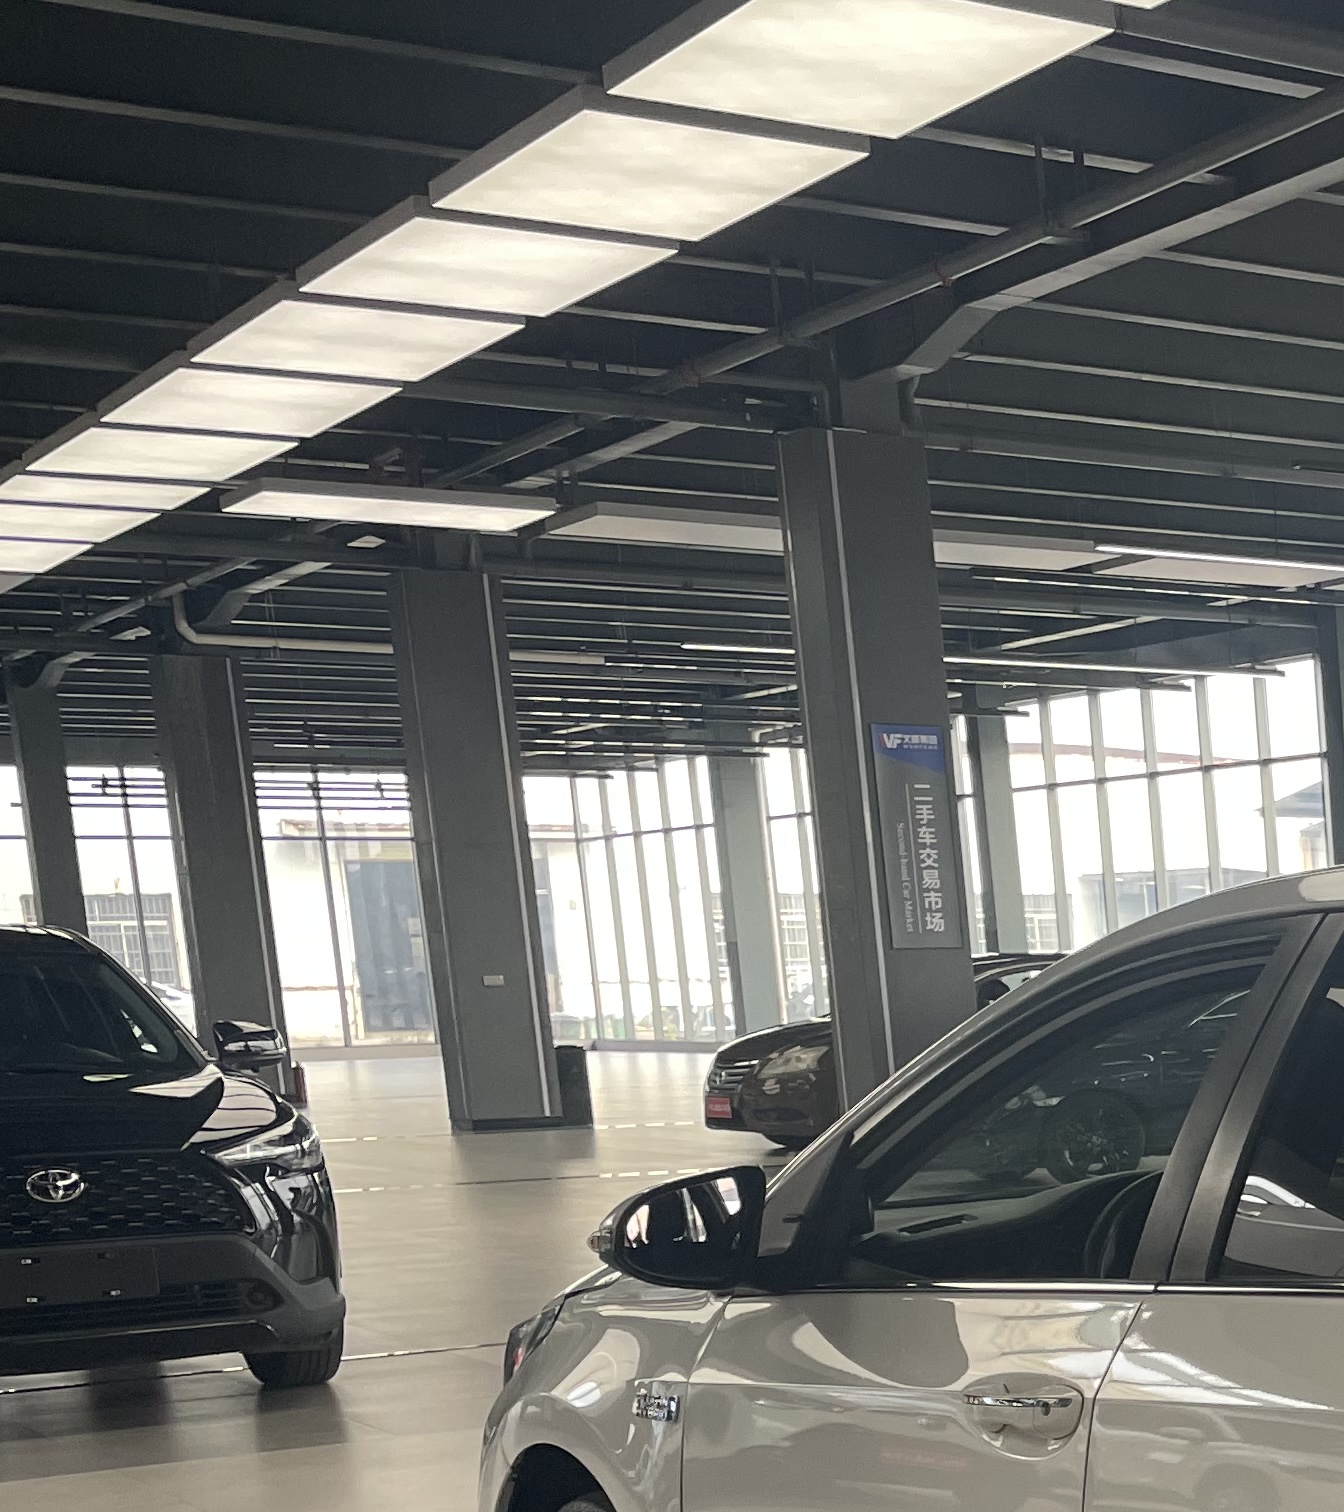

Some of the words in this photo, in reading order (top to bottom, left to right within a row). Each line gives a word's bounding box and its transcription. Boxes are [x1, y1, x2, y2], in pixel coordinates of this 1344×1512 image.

[913, 784, 945, 932] 二手车交易市场
